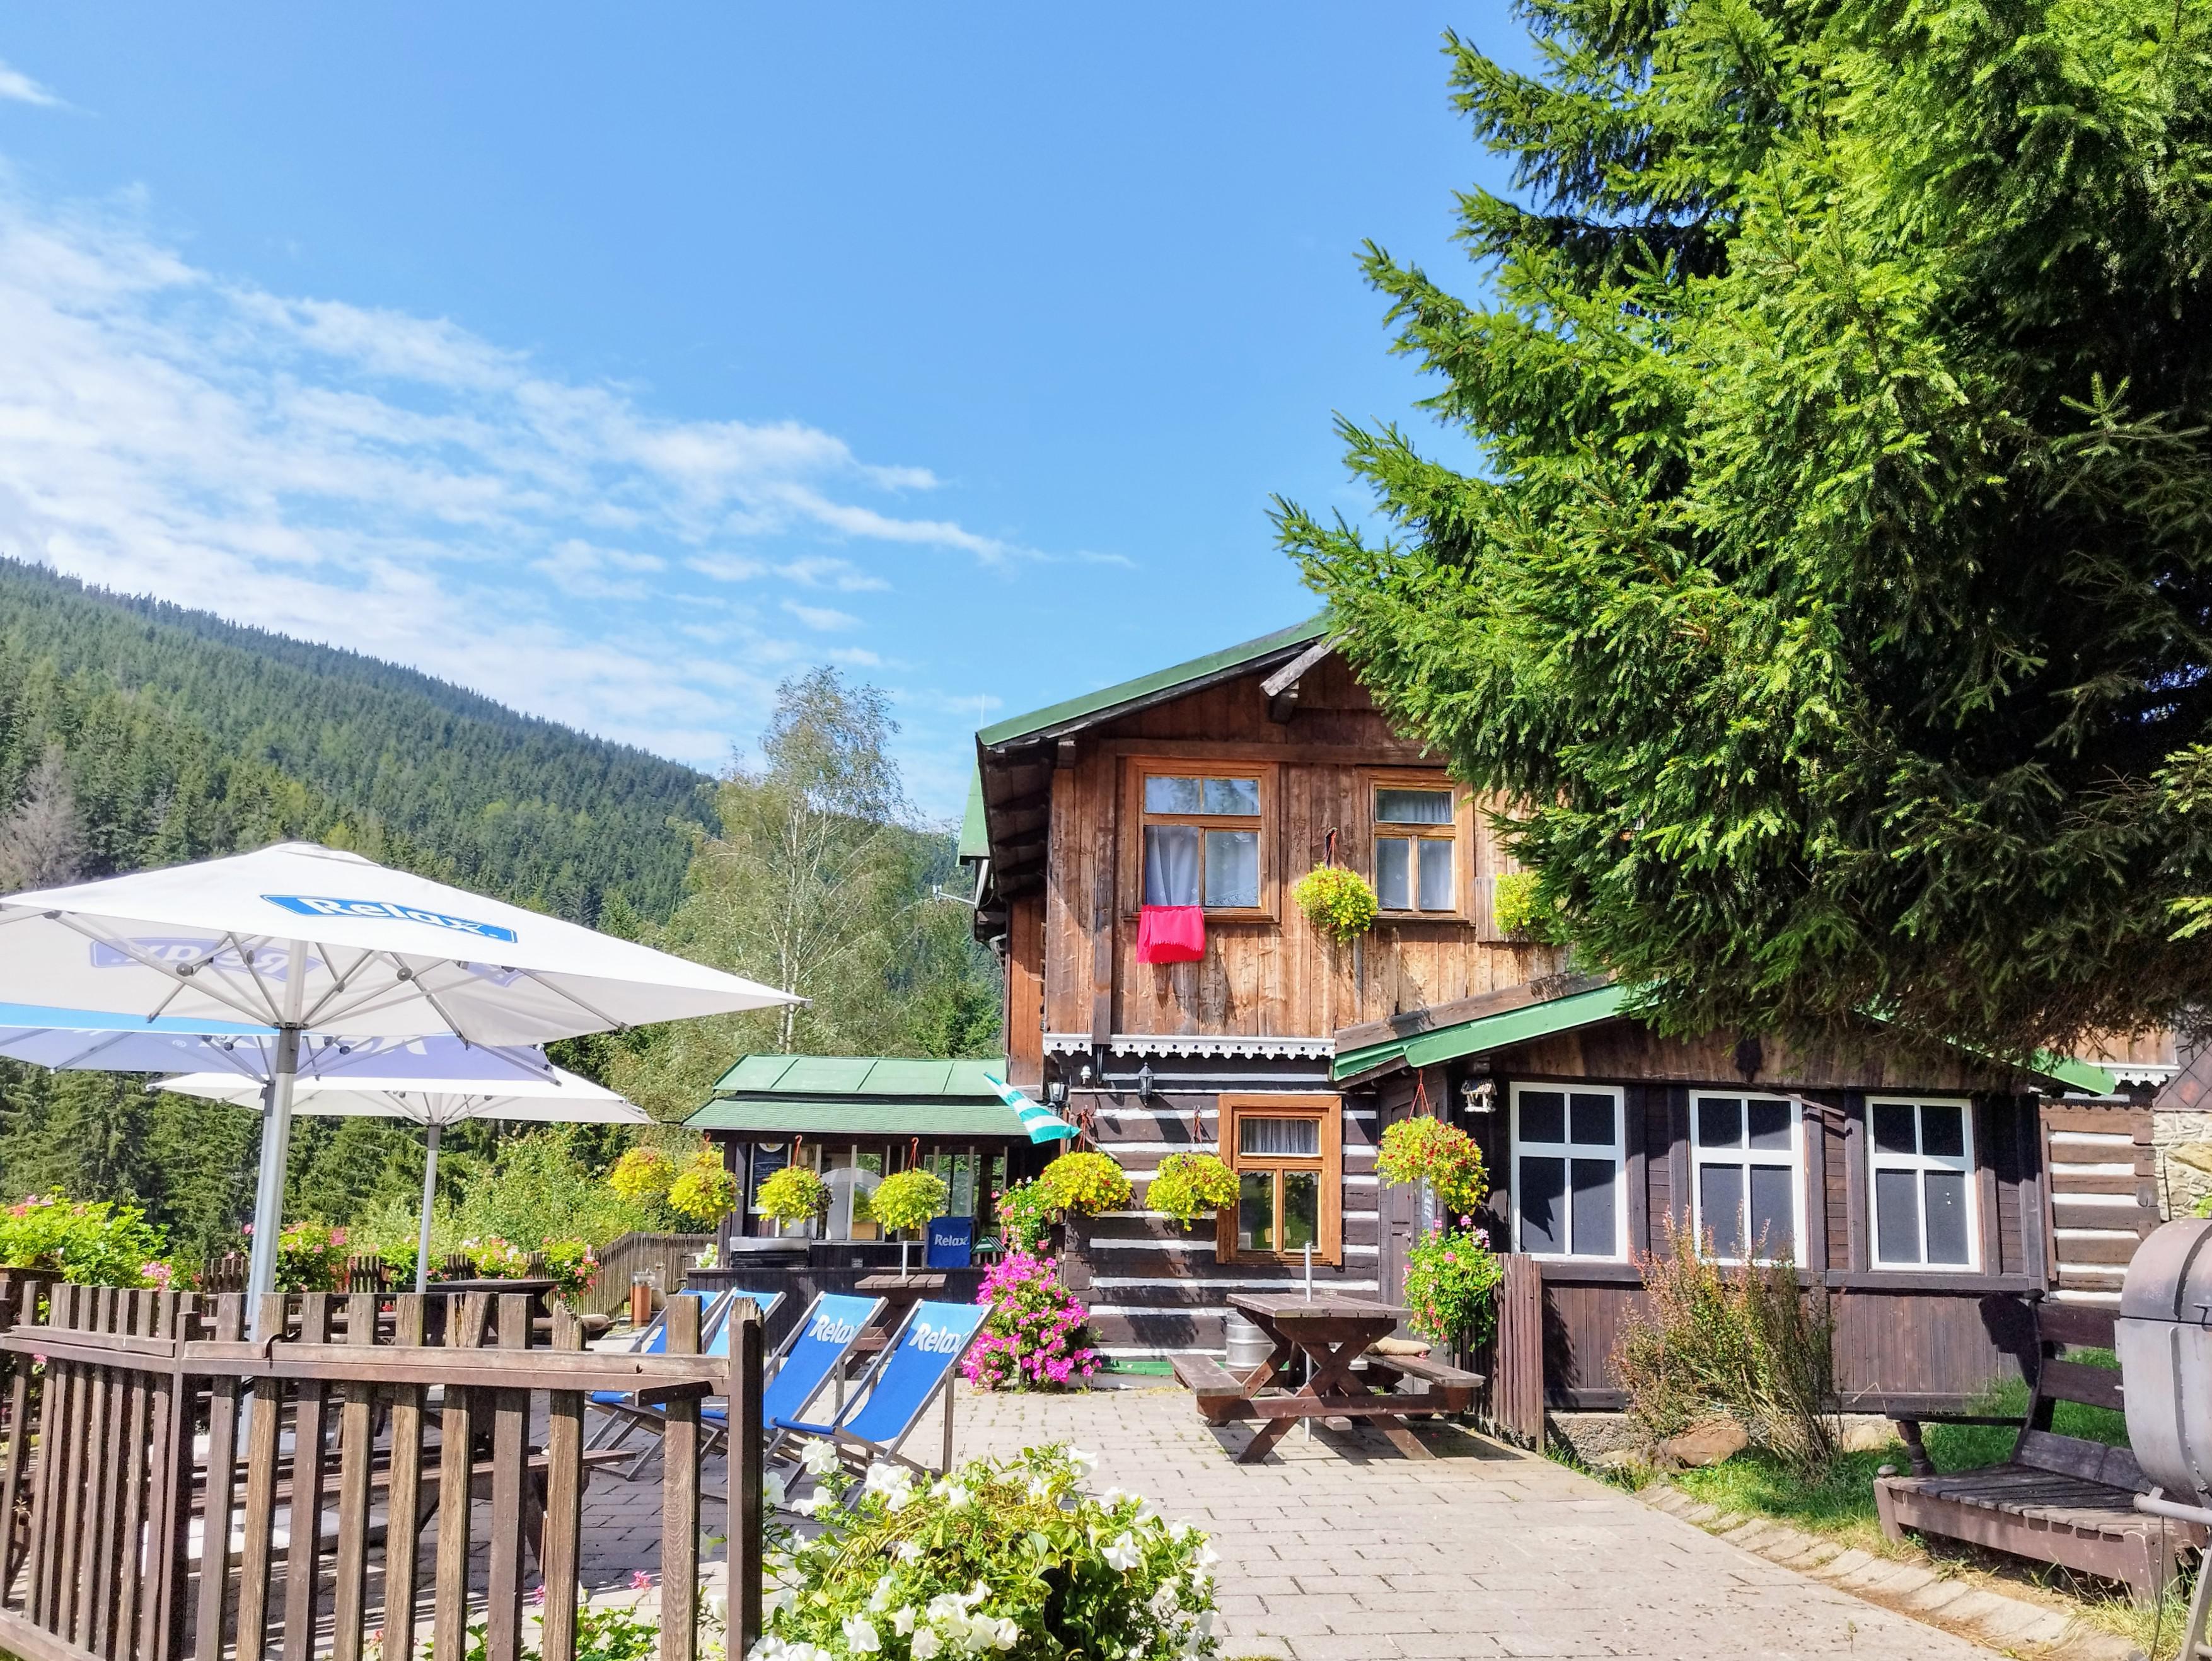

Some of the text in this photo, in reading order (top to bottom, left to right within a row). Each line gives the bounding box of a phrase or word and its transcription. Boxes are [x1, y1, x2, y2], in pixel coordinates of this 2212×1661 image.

[296, 897, 486, 936] Relax
[934, 1234, 968, 1246] Relax
[908, 1322, 970, 1354] Relax
